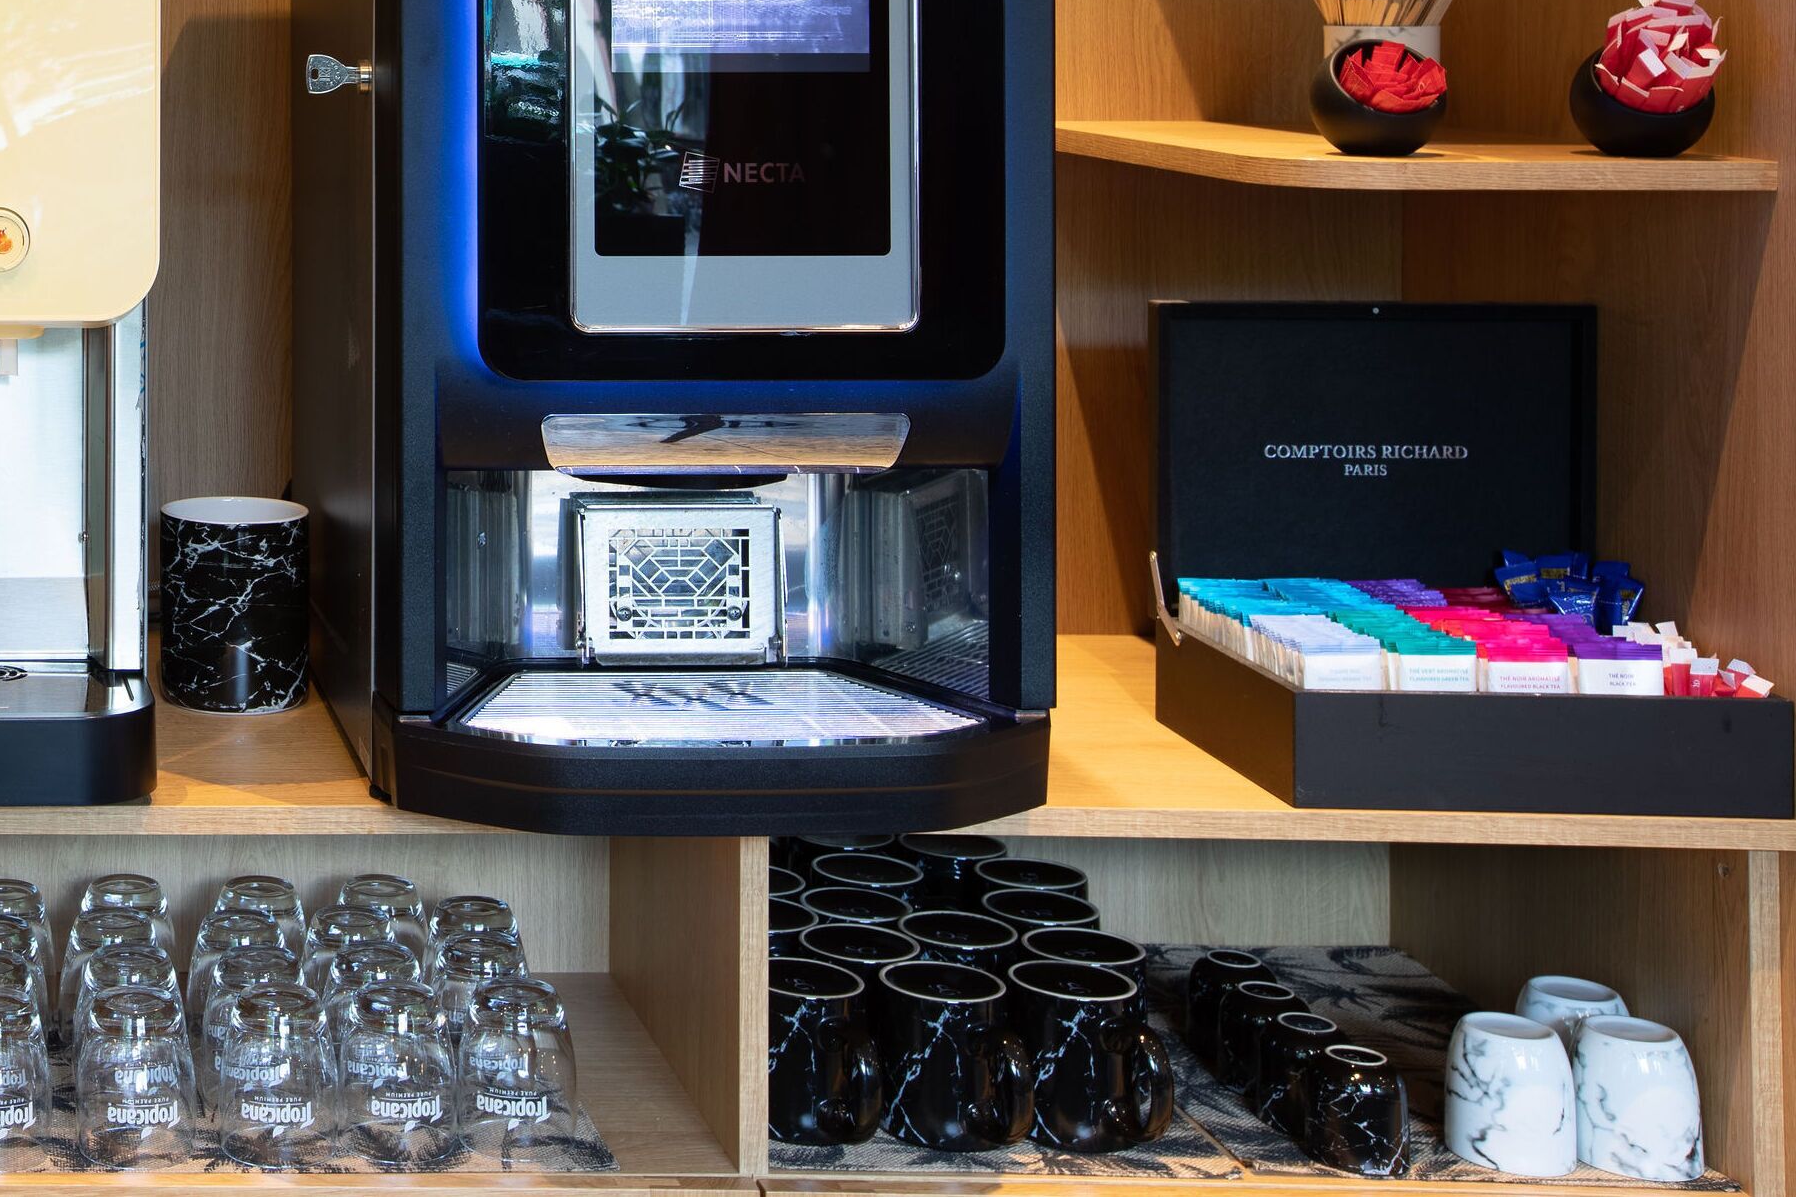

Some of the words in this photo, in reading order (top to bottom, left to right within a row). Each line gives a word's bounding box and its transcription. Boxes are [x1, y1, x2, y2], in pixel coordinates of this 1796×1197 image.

[723, 161, 805, 183] NECTA
[1264, 444, 1377, 459] COMPTOIRS
[1381, 445, 1469, 460] RICHARD
[1343, 464, 1388, 476] PARIS
[107, 1101, 181, 1129] Tropicana
[241, 1101, 315, 1129] Tropicana
[371, 1095, 444, 1123] Tropicana
[477, 1094, 551, 1124] Tropicana
